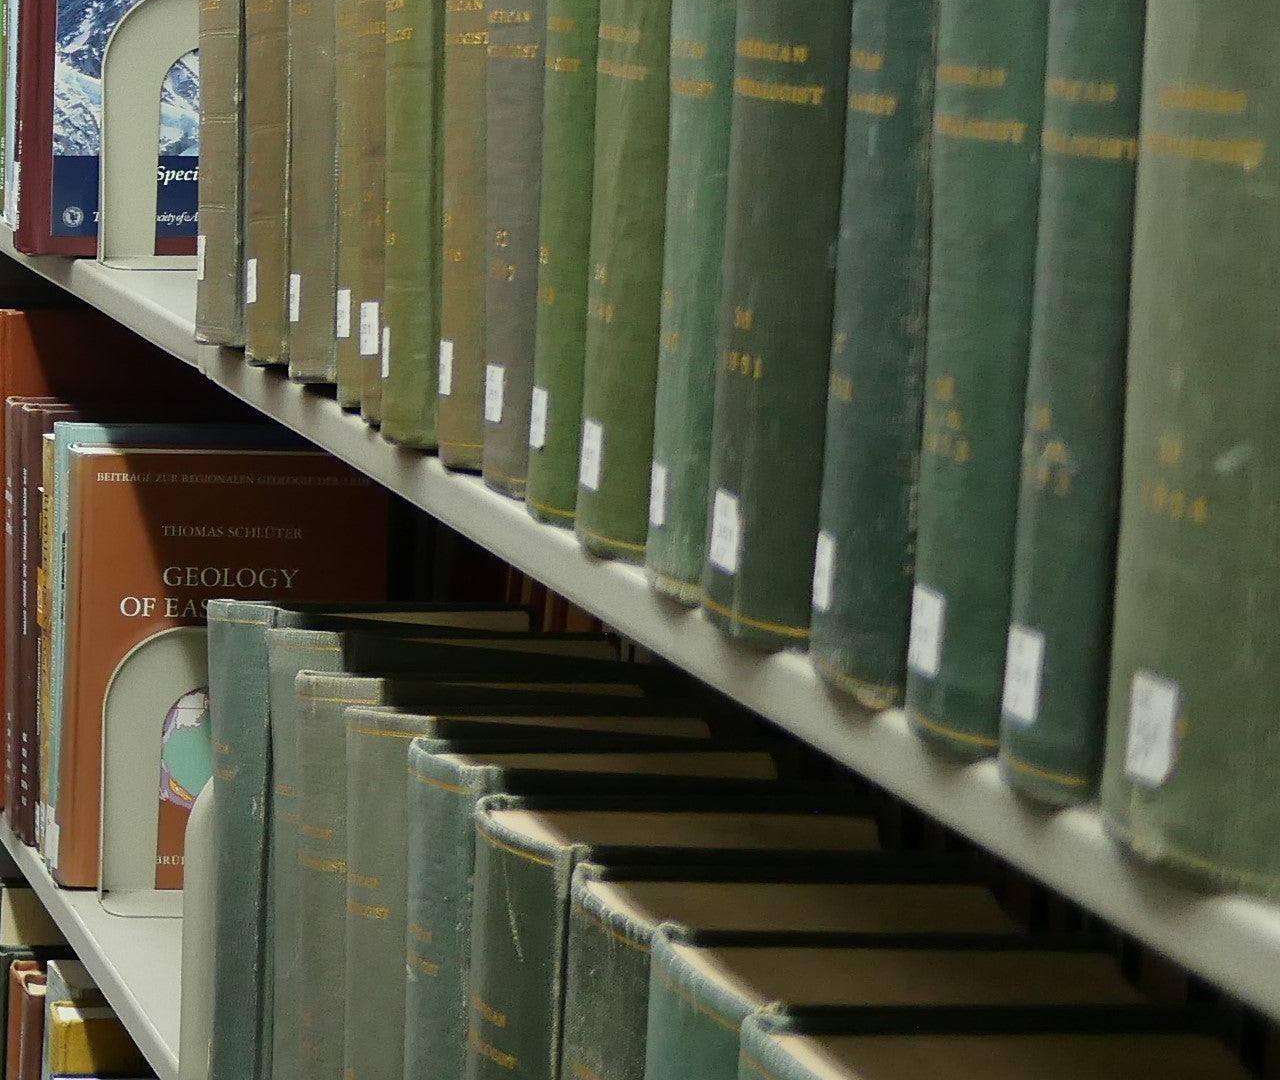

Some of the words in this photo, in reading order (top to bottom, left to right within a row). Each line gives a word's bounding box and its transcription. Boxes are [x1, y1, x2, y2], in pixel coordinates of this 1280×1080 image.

[155, 473, 179, 483] ZUR
[183, 474, 253, 485] REGIONALEN
[161, 525, 224, 537] THOMAS
[228, 525, 303, 540] SCHLÜTER
[163, 566, 300, 589] GEOLOGY
[120, 596, 156, 618] OF
